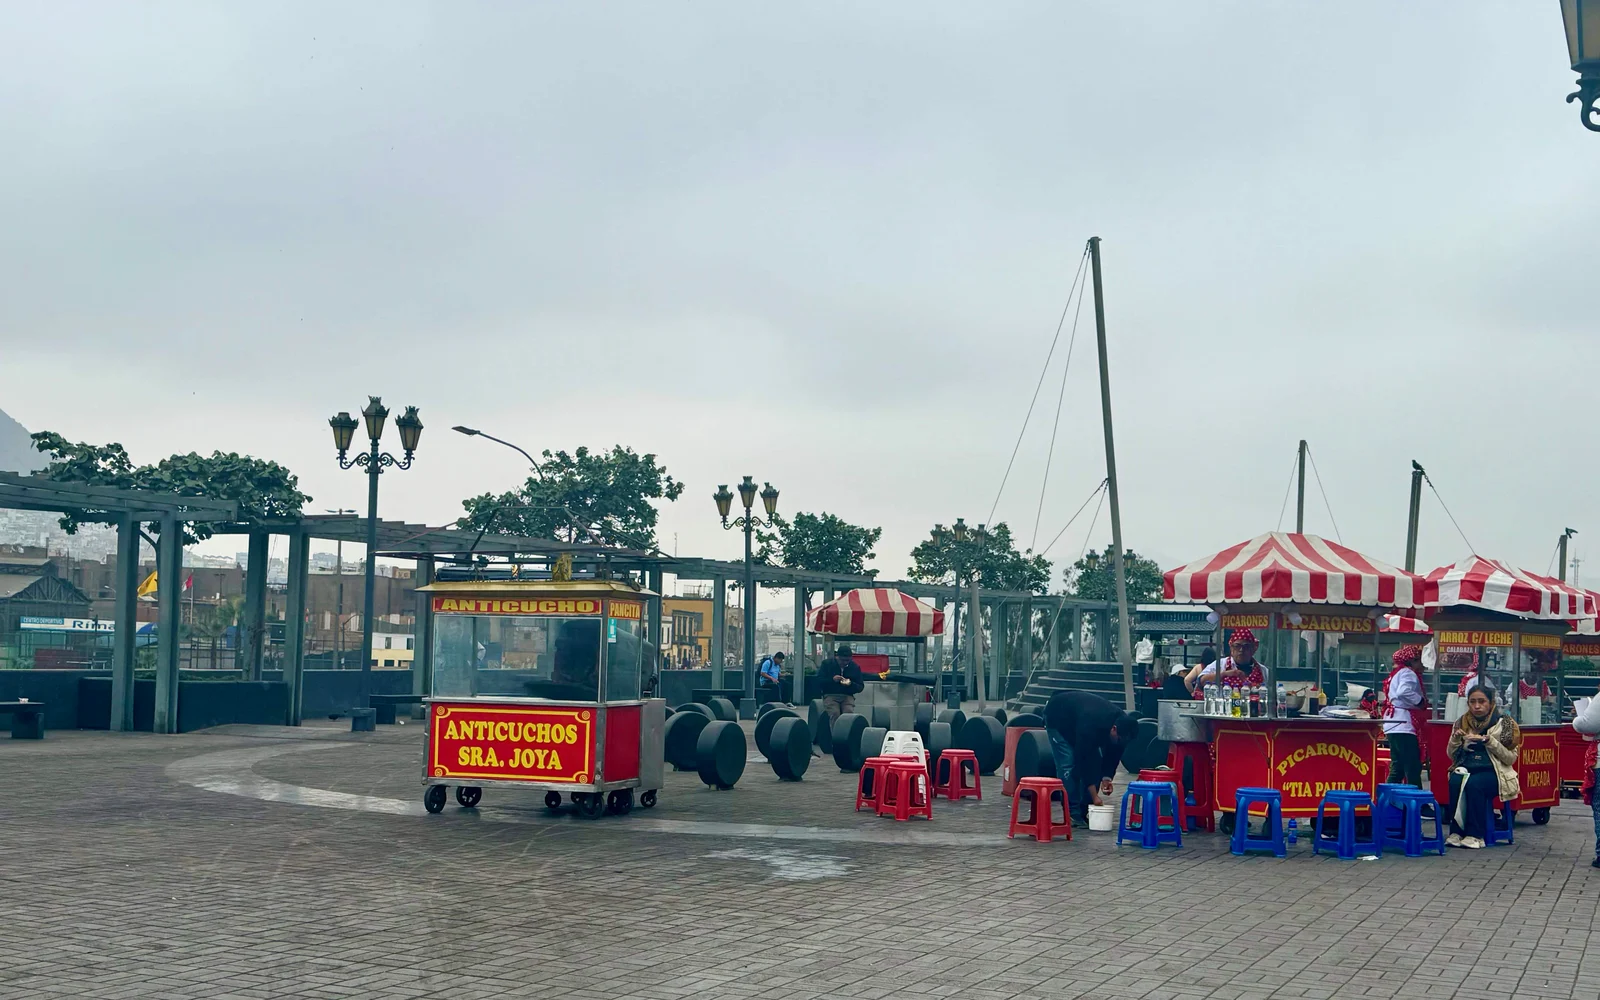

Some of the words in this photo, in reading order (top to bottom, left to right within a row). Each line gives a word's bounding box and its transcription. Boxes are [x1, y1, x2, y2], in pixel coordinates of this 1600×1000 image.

[441, 599, 595, 612] ANTICUCHO
[610, 602, 640, 618] PANCITA
[1222, 614, 1269, 627] PICARONES
[1440, 632, 1469, 643] ARROZ
[1472, 632, 1483, 644] C/
[1484, 633, 1512, 645] LECHE
[1563, 643, 1600, 654] ARONES
[444, 720, 578, 745] ANTICUCHOS
[458, 746, 504, 768] SRA.
[508, 748, 563, 771] JOYA
[1276, 742, 1370, 777] PICARONES
[1522, 748, 1555, 765] MAZAMORRA
[1527, 770, 1551, 787] MORADA
